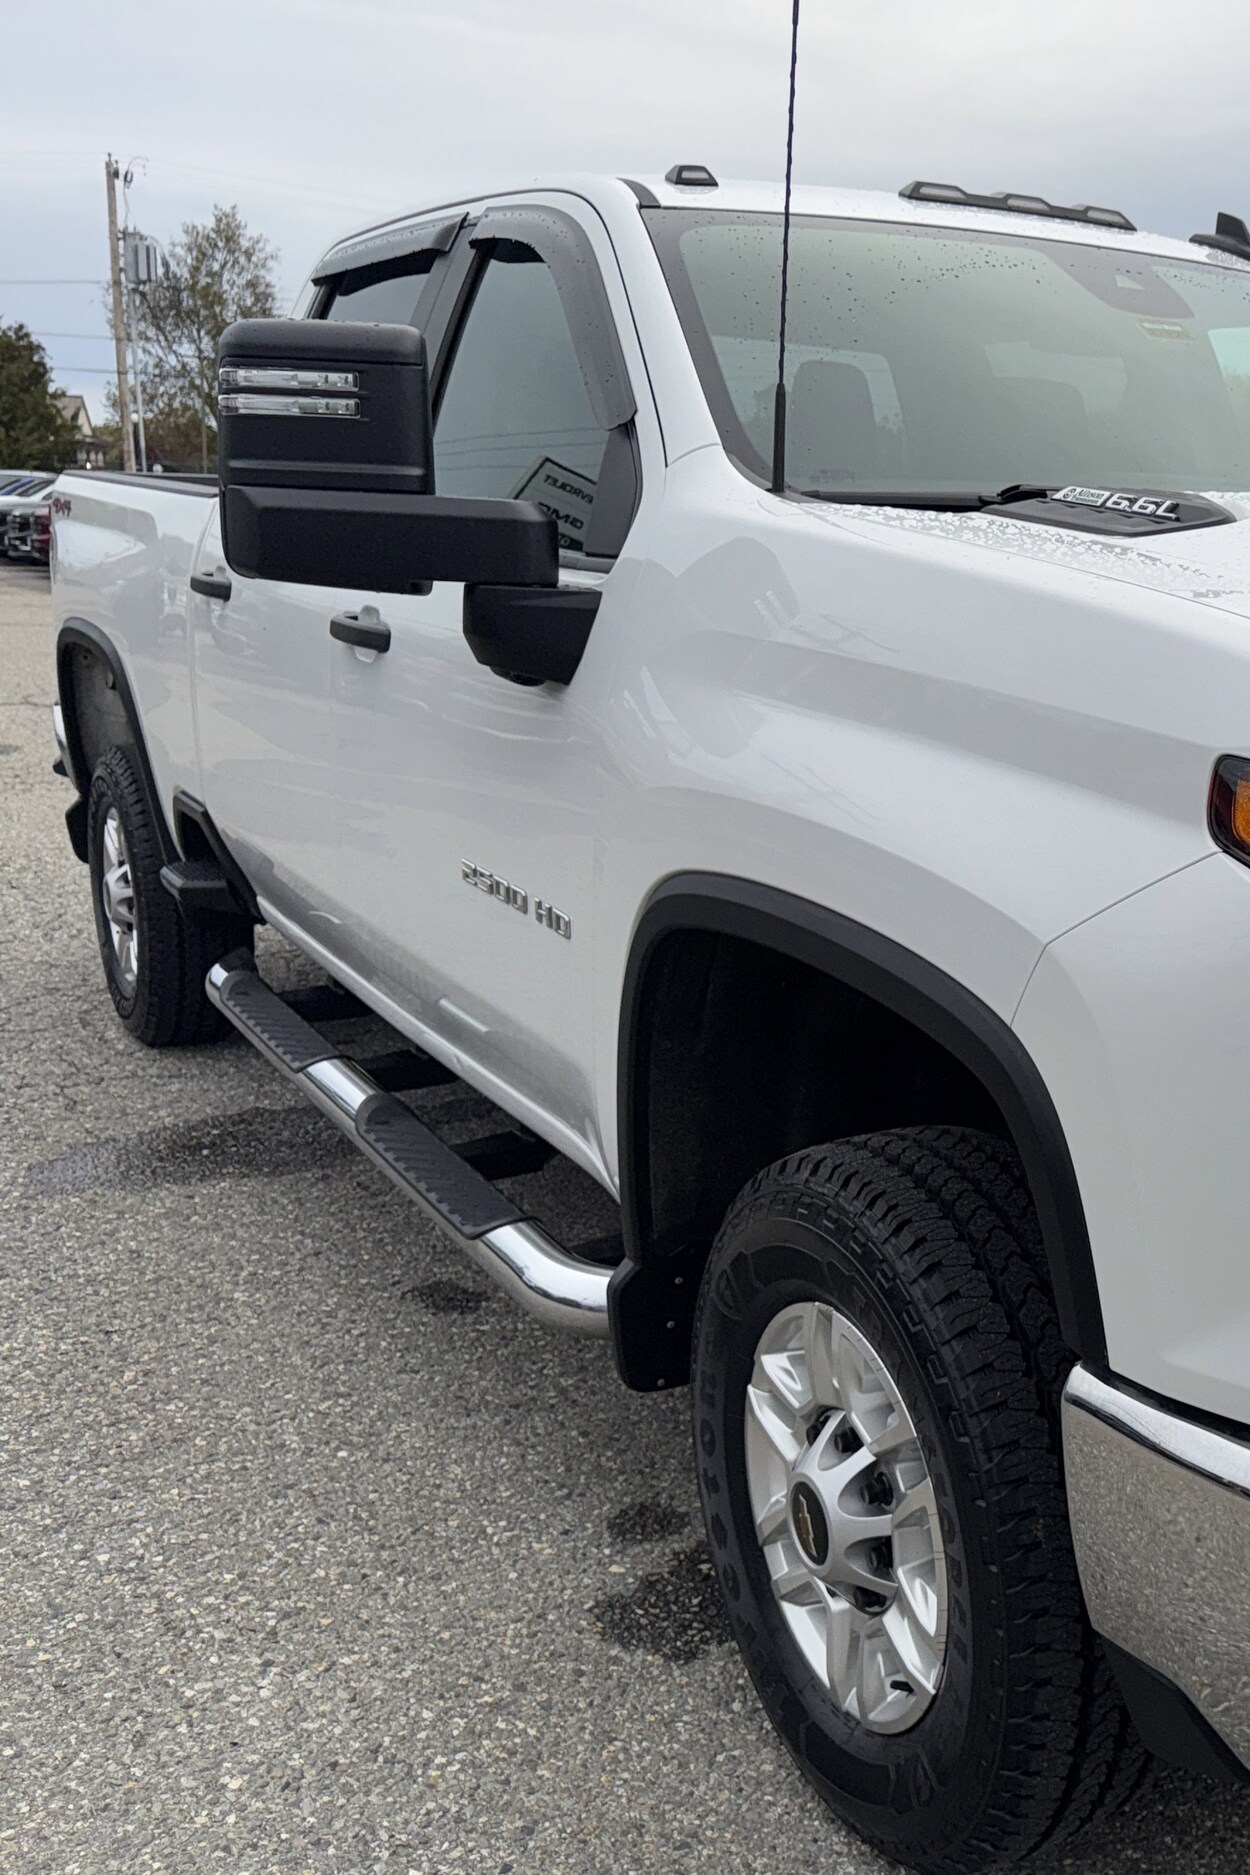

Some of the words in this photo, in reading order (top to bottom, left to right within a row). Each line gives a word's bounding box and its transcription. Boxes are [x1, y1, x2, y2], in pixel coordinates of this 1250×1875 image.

[1105, 493, 1177, 521] 6.6L
[461, 858, 528, 915] 2500
[534, 896, 571, 940] HD
